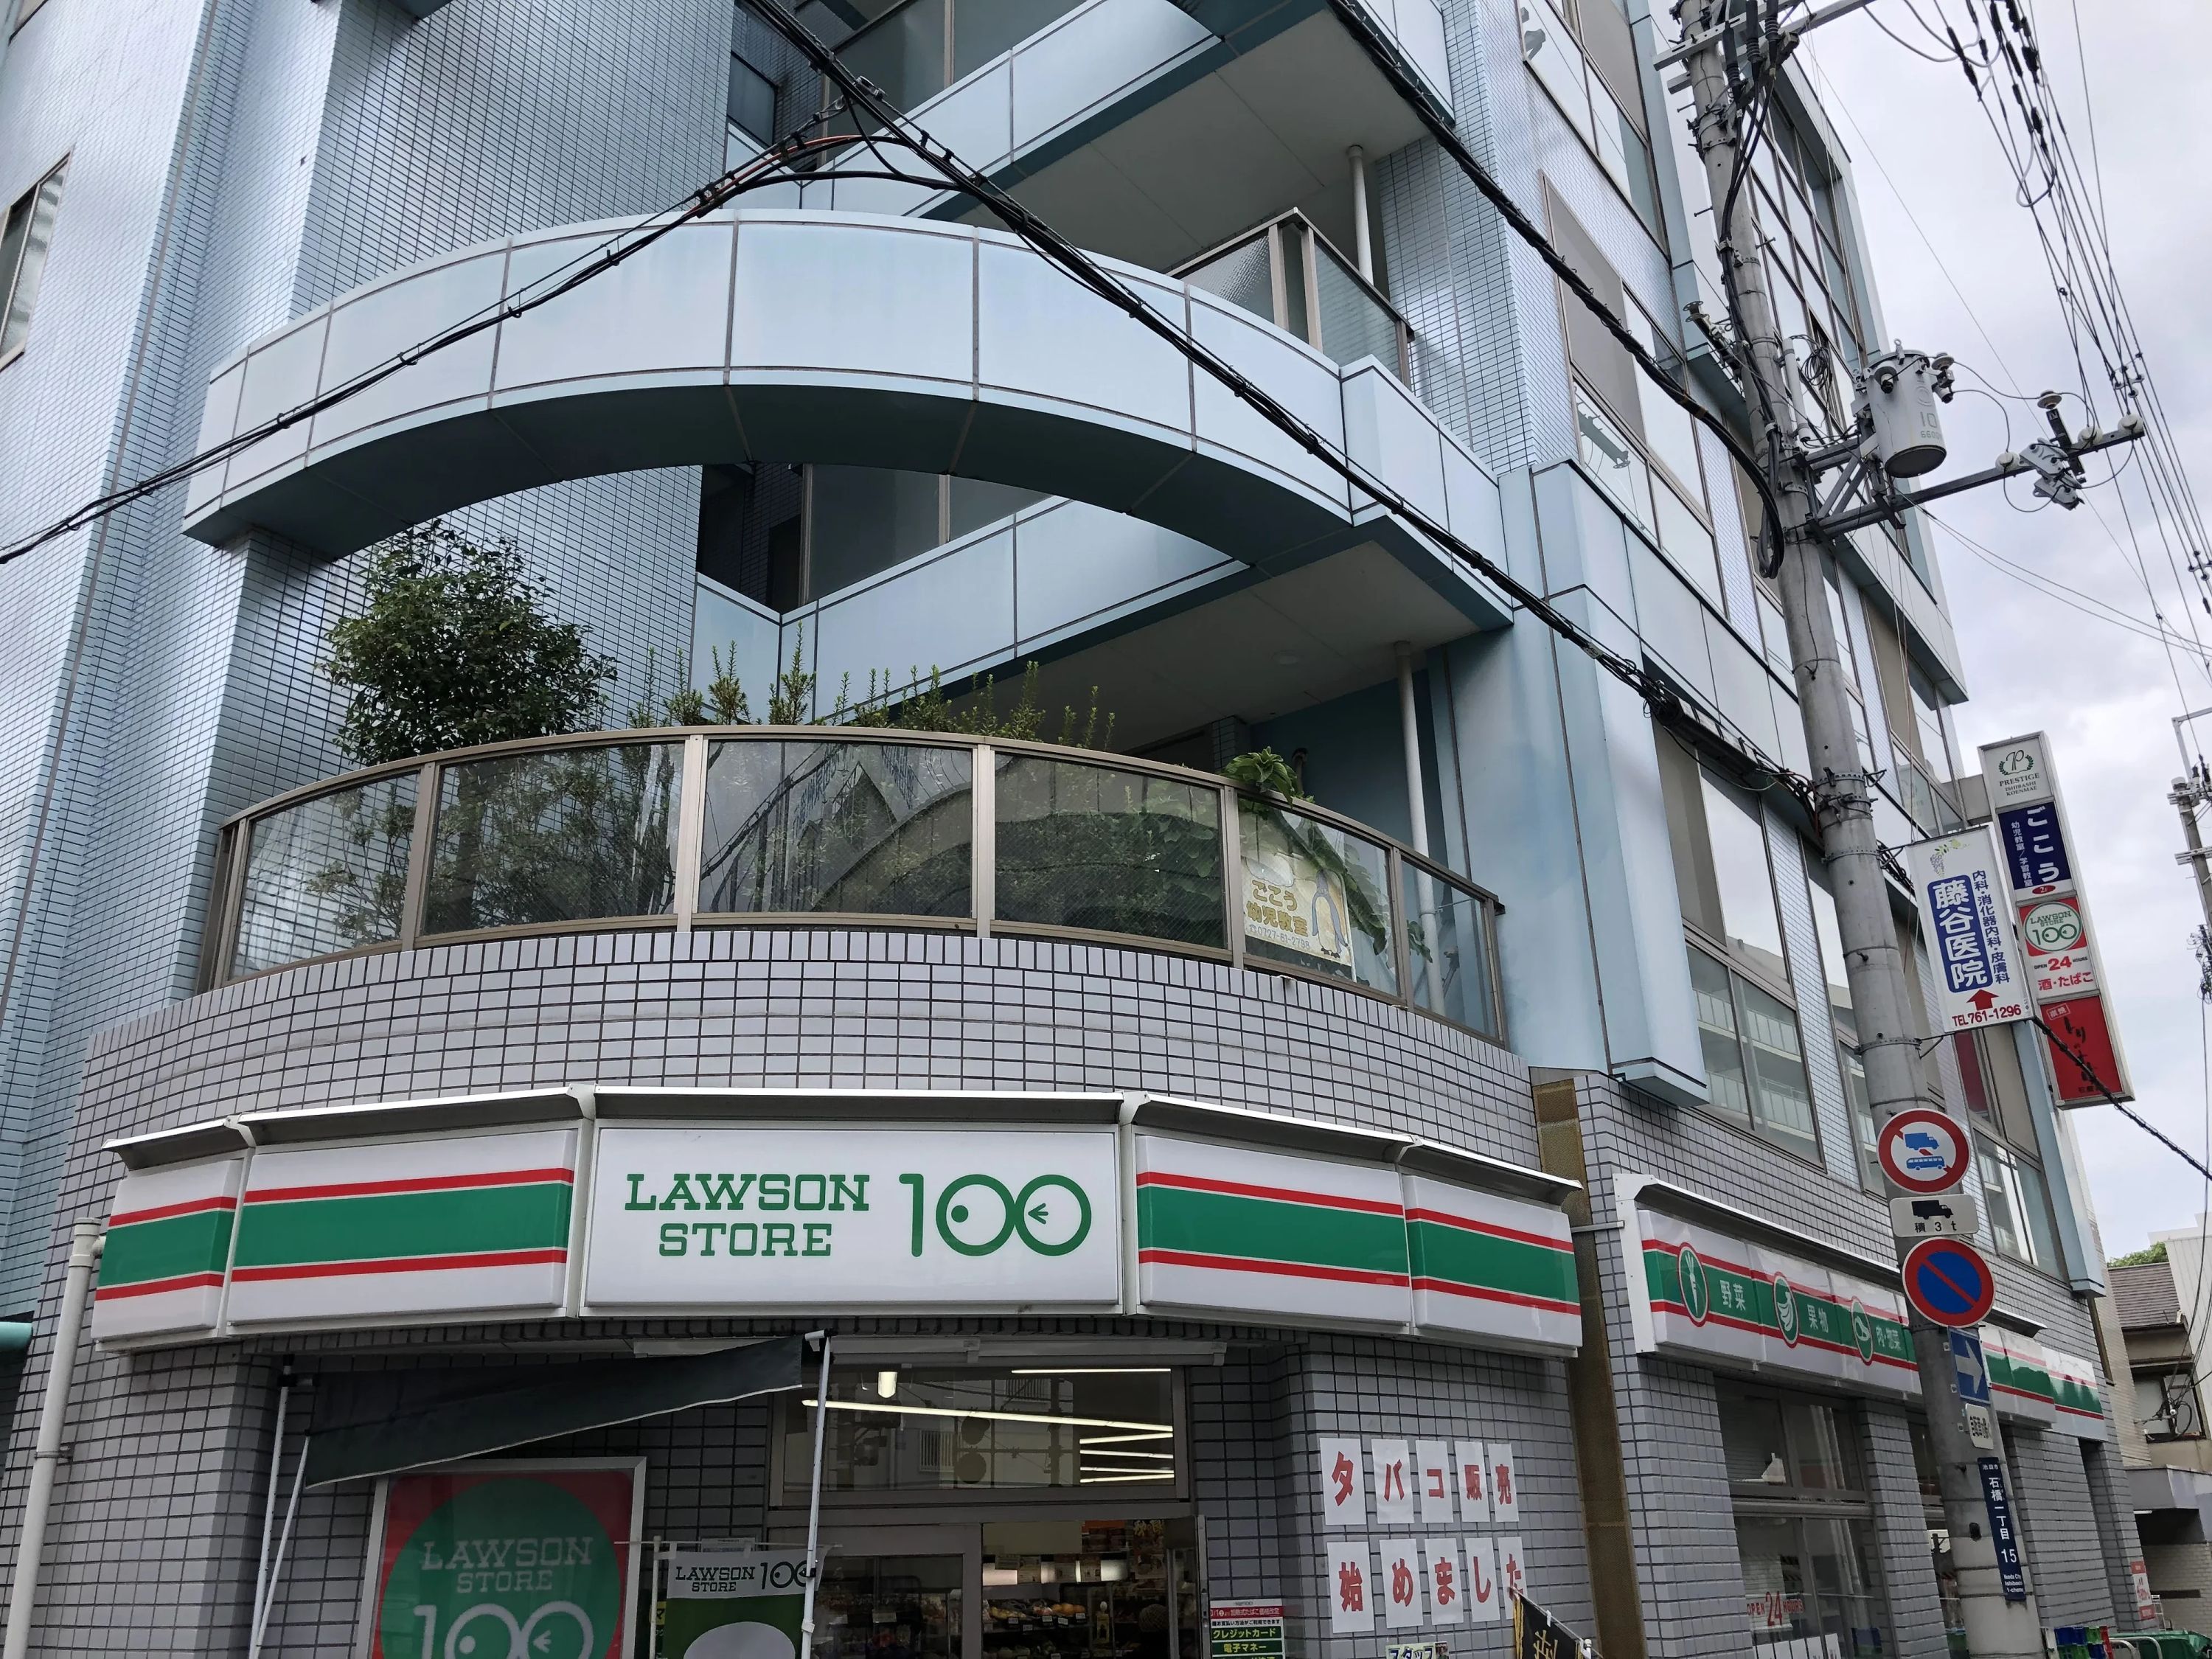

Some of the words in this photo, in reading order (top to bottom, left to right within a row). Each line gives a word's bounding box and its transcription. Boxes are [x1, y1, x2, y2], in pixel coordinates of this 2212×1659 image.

[1999, 773, 2040, 787] PRESTIGE
[1246, 901, 1308, 937] 幼児教室
[2030, 911, 2072, 924] LAWSON
[2039, 919, 2064, 927] STORE
[1933, 879, 1988, 990] 藤谷医院
[2032, 923, 2077, 945] 100
[2048, 956, 2072, 971] 24
[625, 1173, 870, 1211] LAWSON
[899, 1173, 1092, 1257] 100
[658, 1222, 832, 1256] STORE
[1719, 1279, 1746, 1311] 野菜
[1807, 1304, 1829, 1333] 果物
[1989, 1477, 2010, 1540] 石橋一丁目
[421, 1537, 594, 1571] LAWSON
[2000, 1548, 2017, 1563] 15
[456, 1570, 553, 1593] STORE
[675, 1566, 756, 1581] LAWSON
[692, 1582, 737, 1592] STORE
[1747, 1602, 1765, 1615] OPEN
[1766, 1591, 1782, 1627] 24
[1783, 1599, 1805, 1613] HOURS
[1213, 1628, 1276, 1638] クレジットカード
[1224, 1644, 1267, 1652] 電子マネー
